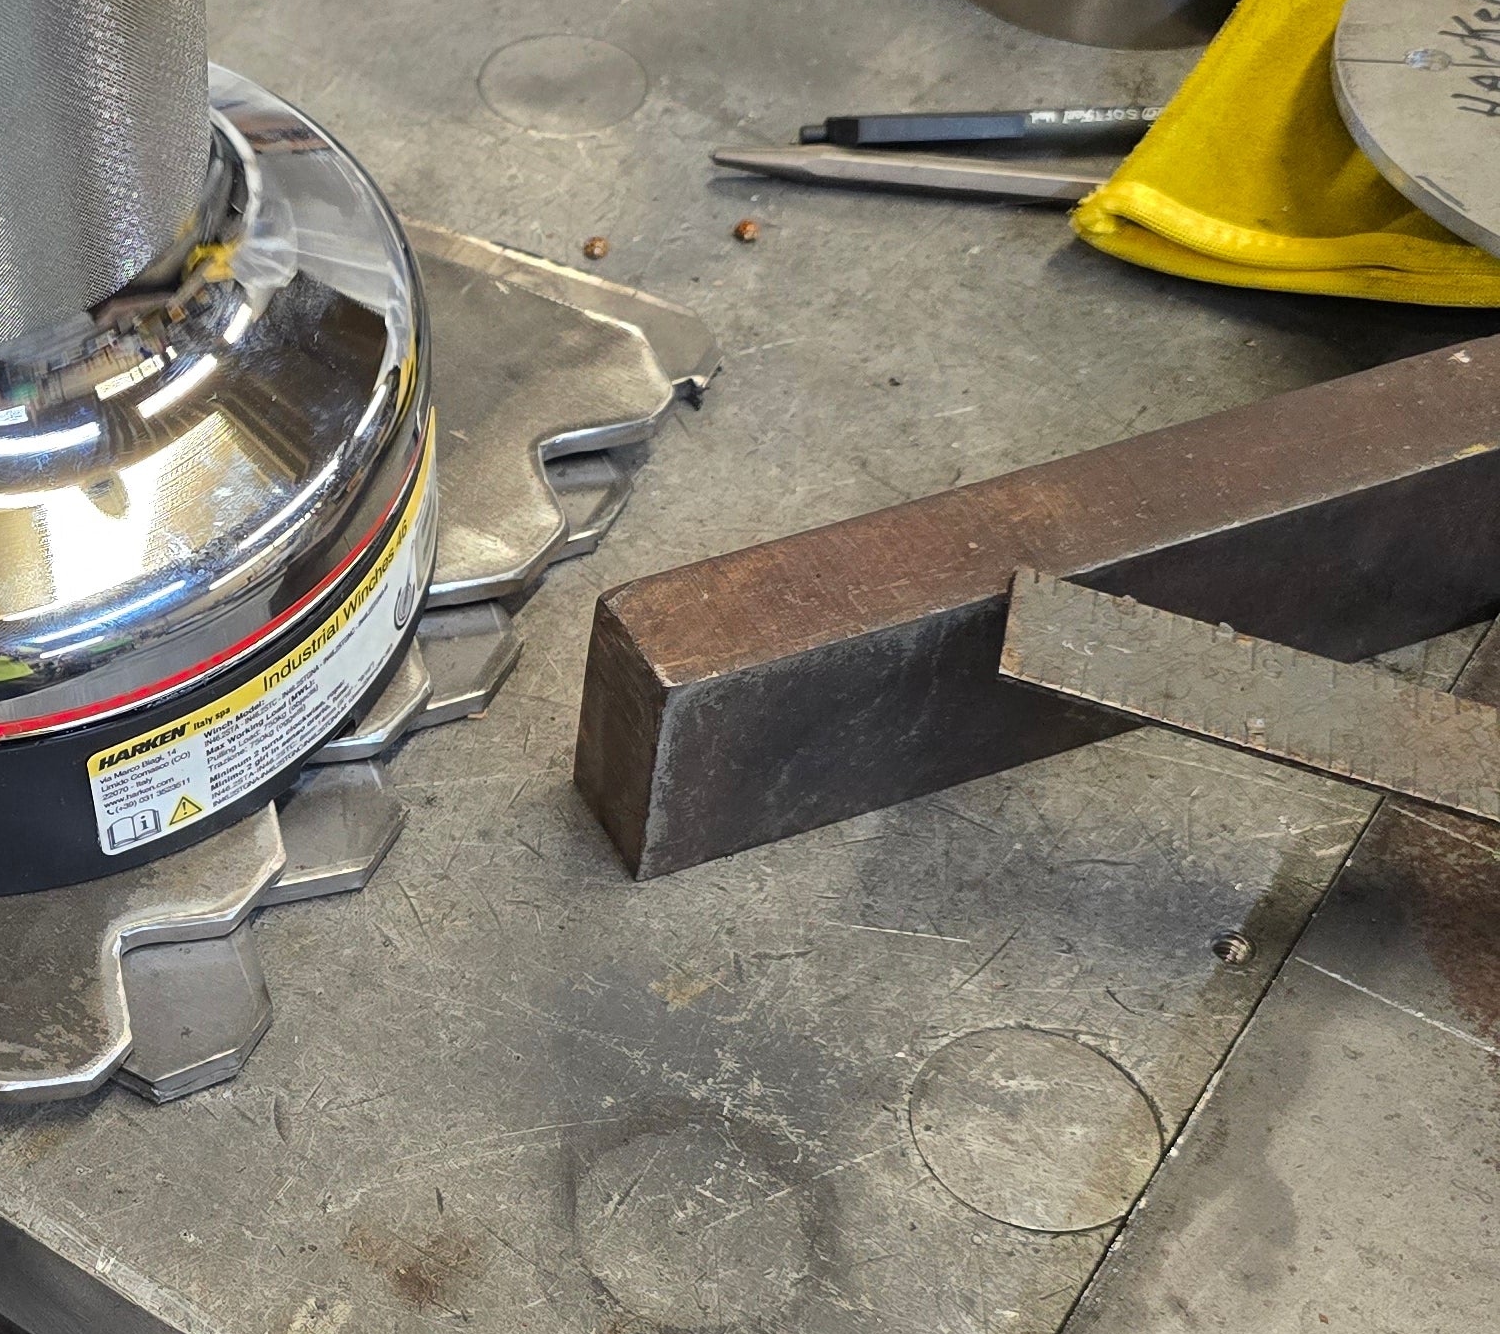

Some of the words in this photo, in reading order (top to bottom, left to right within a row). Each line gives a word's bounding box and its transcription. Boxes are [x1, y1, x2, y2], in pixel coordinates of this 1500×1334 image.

[98, 723, 189, 771] HARKEN
[193, 716, 214, 730] Italy
[215, 707, 232, 721] spa
[263, 619, 341, 692] Industrial
[343, 550, 394, 620] Winches
[396, 520, 408, 549] 46
[204, 719, 233, 739] Winch
[205, 743, 226, 757] Max
[227, 720, 264, 745] Working
[265, 701, 287, 724] Load
[101, 778, 129, 792] Limido
[130, 762, 169, 781] Comasco
[171, 750, 191, 766] (CO)
[206, 744, 237, 765] Pulling
[209, 755, 252, 784] Minimum
[253, 750, 260, 758] 2
[261, 733, 284, 754] turns
[210, 769, 245, 792] Minimo
[246, 762, 253, 772] 2
[270, 744, 280, 755] in
[99, 775, 112, 784] via
[114, 765, 140, 779] Marco
[103, 776, 175, 808] www.harken.com
[136, 776, 153, 788] Italy
